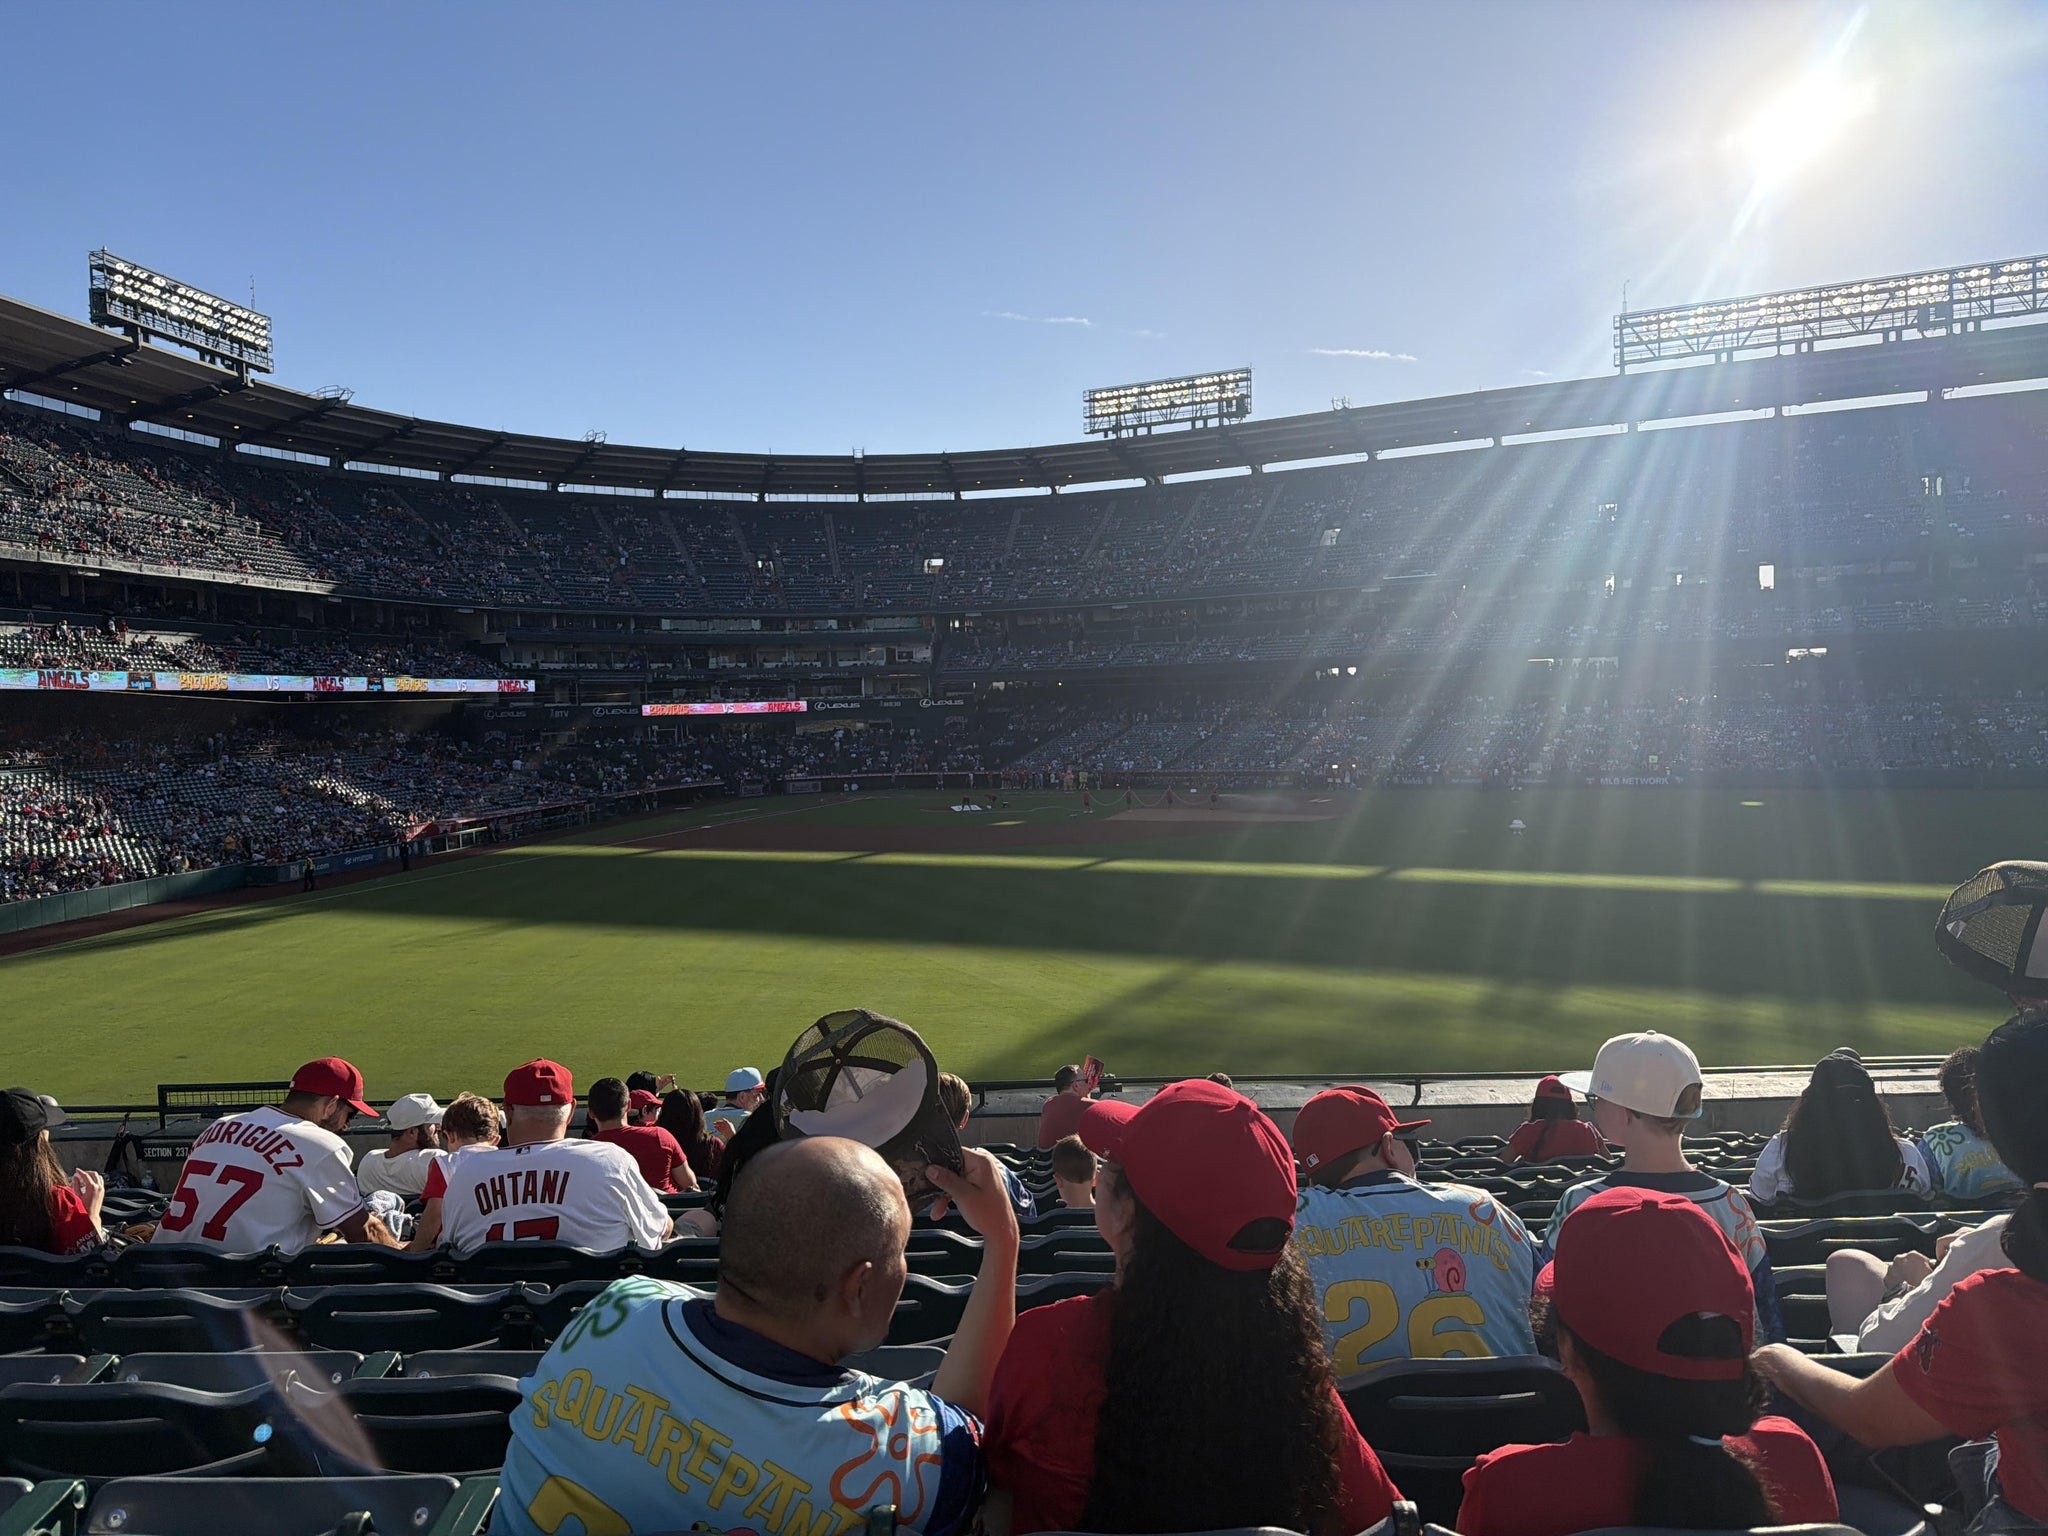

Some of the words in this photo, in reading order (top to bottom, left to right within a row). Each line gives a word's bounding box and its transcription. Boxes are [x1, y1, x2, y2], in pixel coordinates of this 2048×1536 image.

[37, 671, 90, 689] ANGELS
[179, 674, 229, 690] BREWERS
[265, 676, 280, 690] VS
[313, 676, 345, 691] ANGELS
[395, 678, 429, 692] BREWERS
[456, 680, 468, 692] VS
[497, 680, 529, 692] ANGELS
[495, 710, 527, 718] LEXUS
[721, 702, 735, 714] VS
[767, 701, 801, 712] ANGELS
[1622, 777, 1669, 785] NETWORK
[143, 1147, 172, 1158] SECTION
[175, 1147, 188, 1157] 237
[161, 1160, 264, 1241] 57
[474, 1169, 571, 1216] OHTANI
[1323, 1278, 1495, 1377] 26
